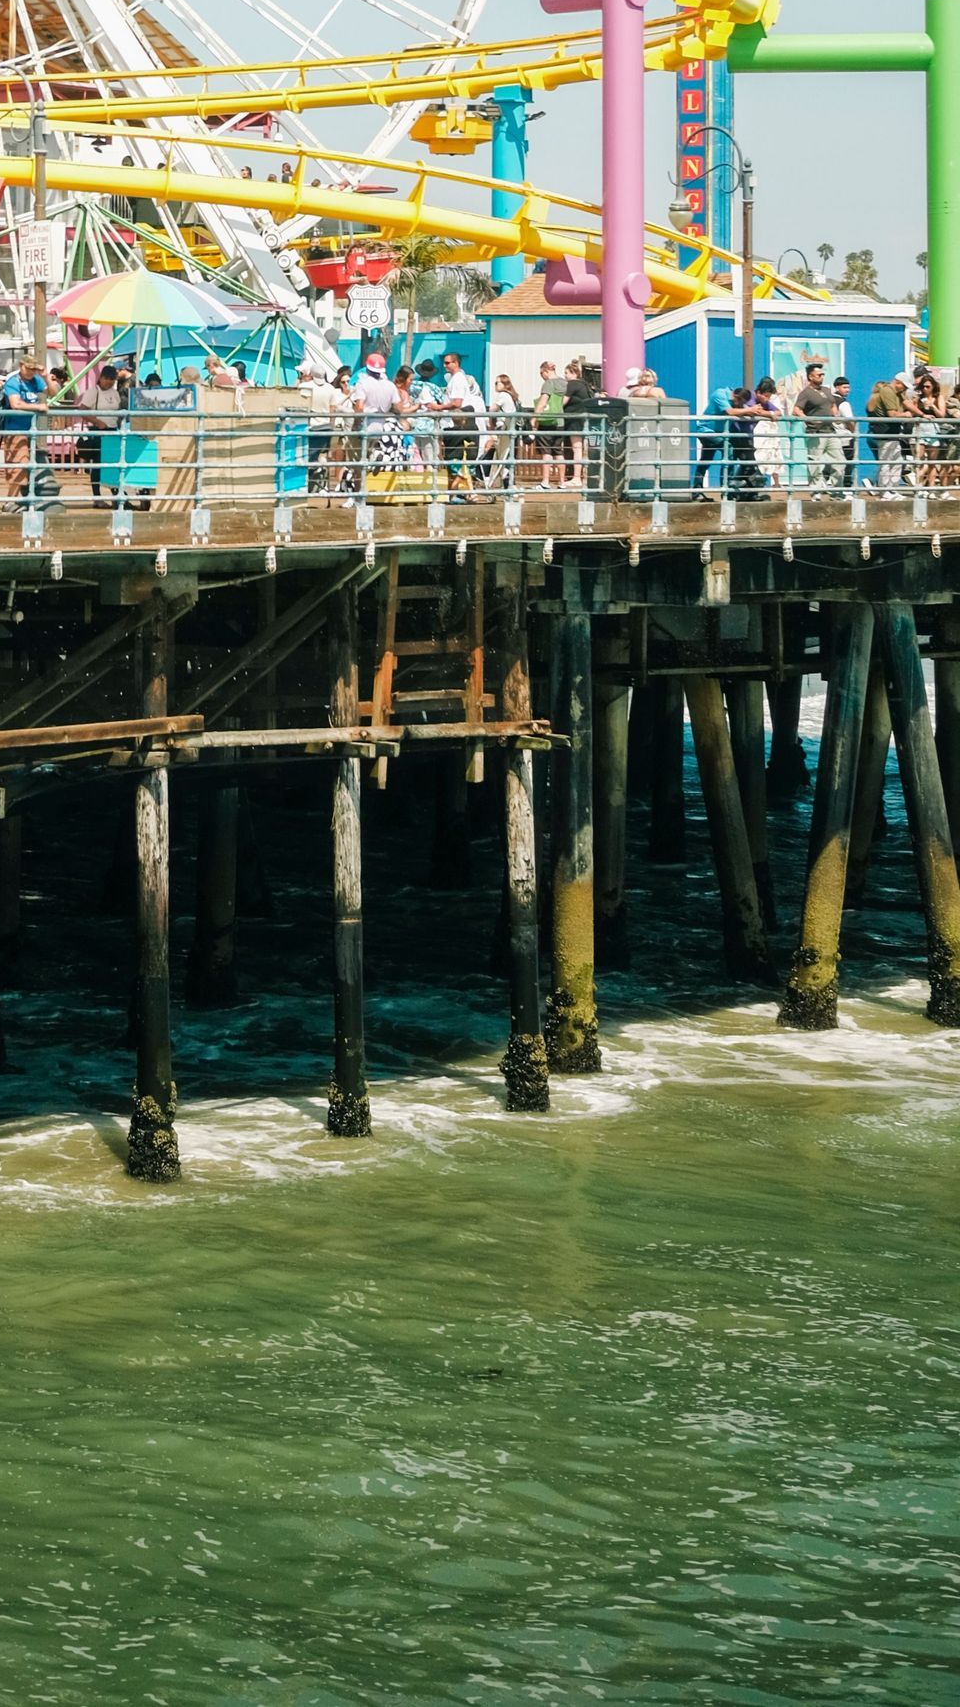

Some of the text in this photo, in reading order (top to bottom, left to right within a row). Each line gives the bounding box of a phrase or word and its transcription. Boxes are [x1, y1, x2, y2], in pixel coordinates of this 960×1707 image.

[25, 248, 47, 263] FIRE
[23, 263, 49, 279] LANE
[360, 300, 378, 308] ROUTE
[359, 309, 379, 323] 66
